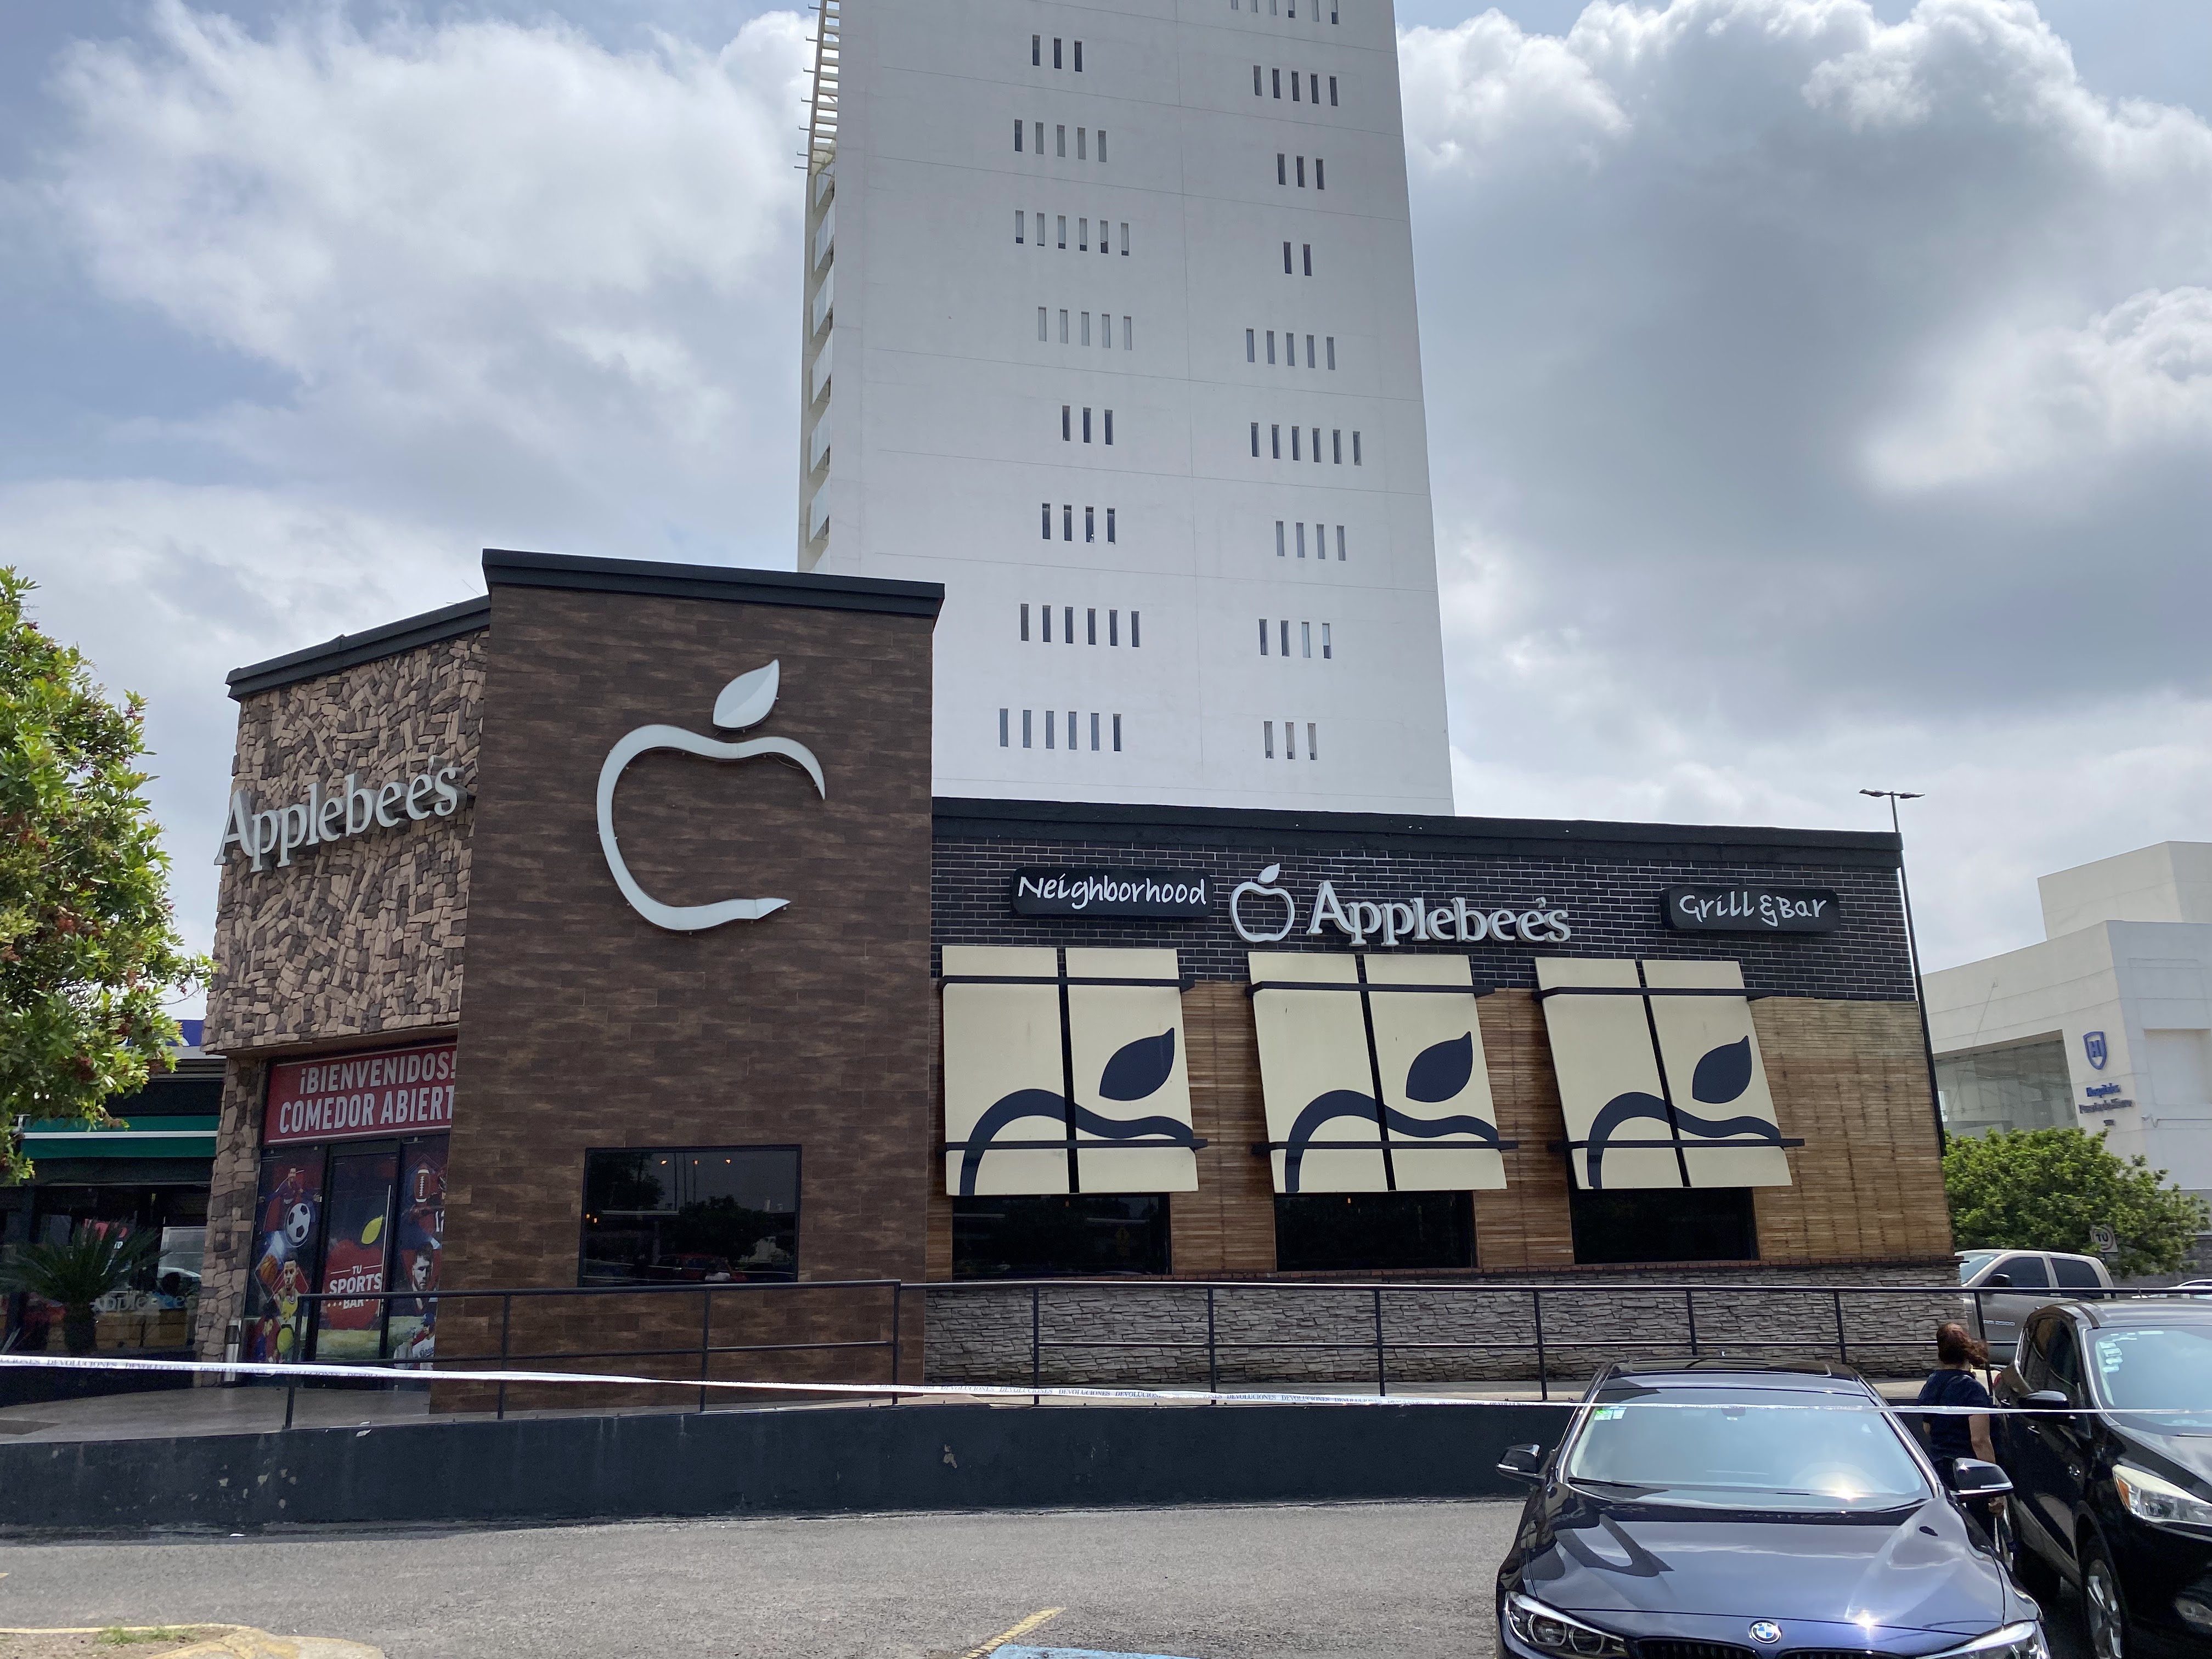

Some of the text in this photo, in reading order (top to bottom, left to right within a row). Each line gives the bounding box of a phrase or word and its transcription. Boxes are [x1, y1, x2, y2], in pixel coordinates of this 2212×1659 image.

[1018, 873, 1206, 910] Neighborhood
[1679, 890, 1755, 923] Grill
[1776, 895, 1827, 918] Bar
[1306, 879, 1571, 946] Applebee's
[300, 1050, 457, 1095] ¡BIENVENIDOS!
[279, 1092, 375, 1134] COMEDOR
[329, 1272, 382, 1294] SPORTS
[352, 1265, 362, 1275] TU
[1059, 1388, 1110, 1396] DEVOLUCIONES
